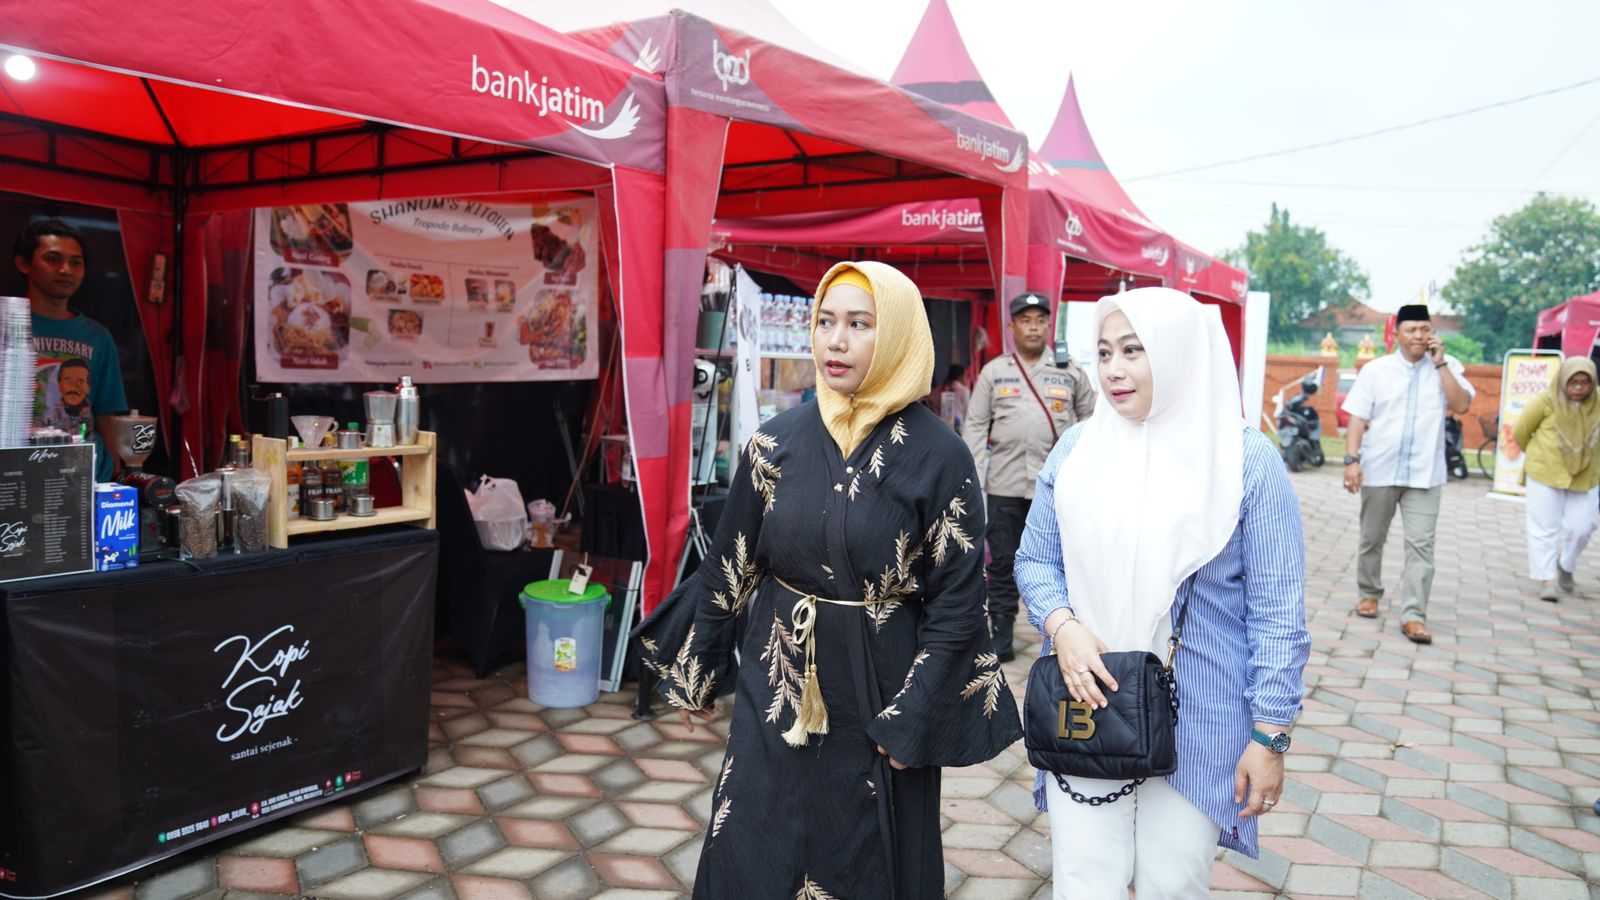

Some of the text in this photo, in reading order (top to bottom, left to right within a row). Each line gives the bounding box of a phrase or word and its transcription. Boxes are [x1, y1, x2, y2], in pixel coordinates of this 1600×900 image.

[471, 53, 605, 124] bankjatim
[956, 126, 1010, 164] bankjatim
[901, 208, 984, 230] bankjatim
[32, 336, 94, 361] NIVERSARY
[101, 499, 135, 509] Diamond
[101, 508, 136, 540] Milk
[213, 624, 310, 689] Kopi
[216, 676, 304, 742] Sajak
[230, 736, 293, 761] santai sejenak
